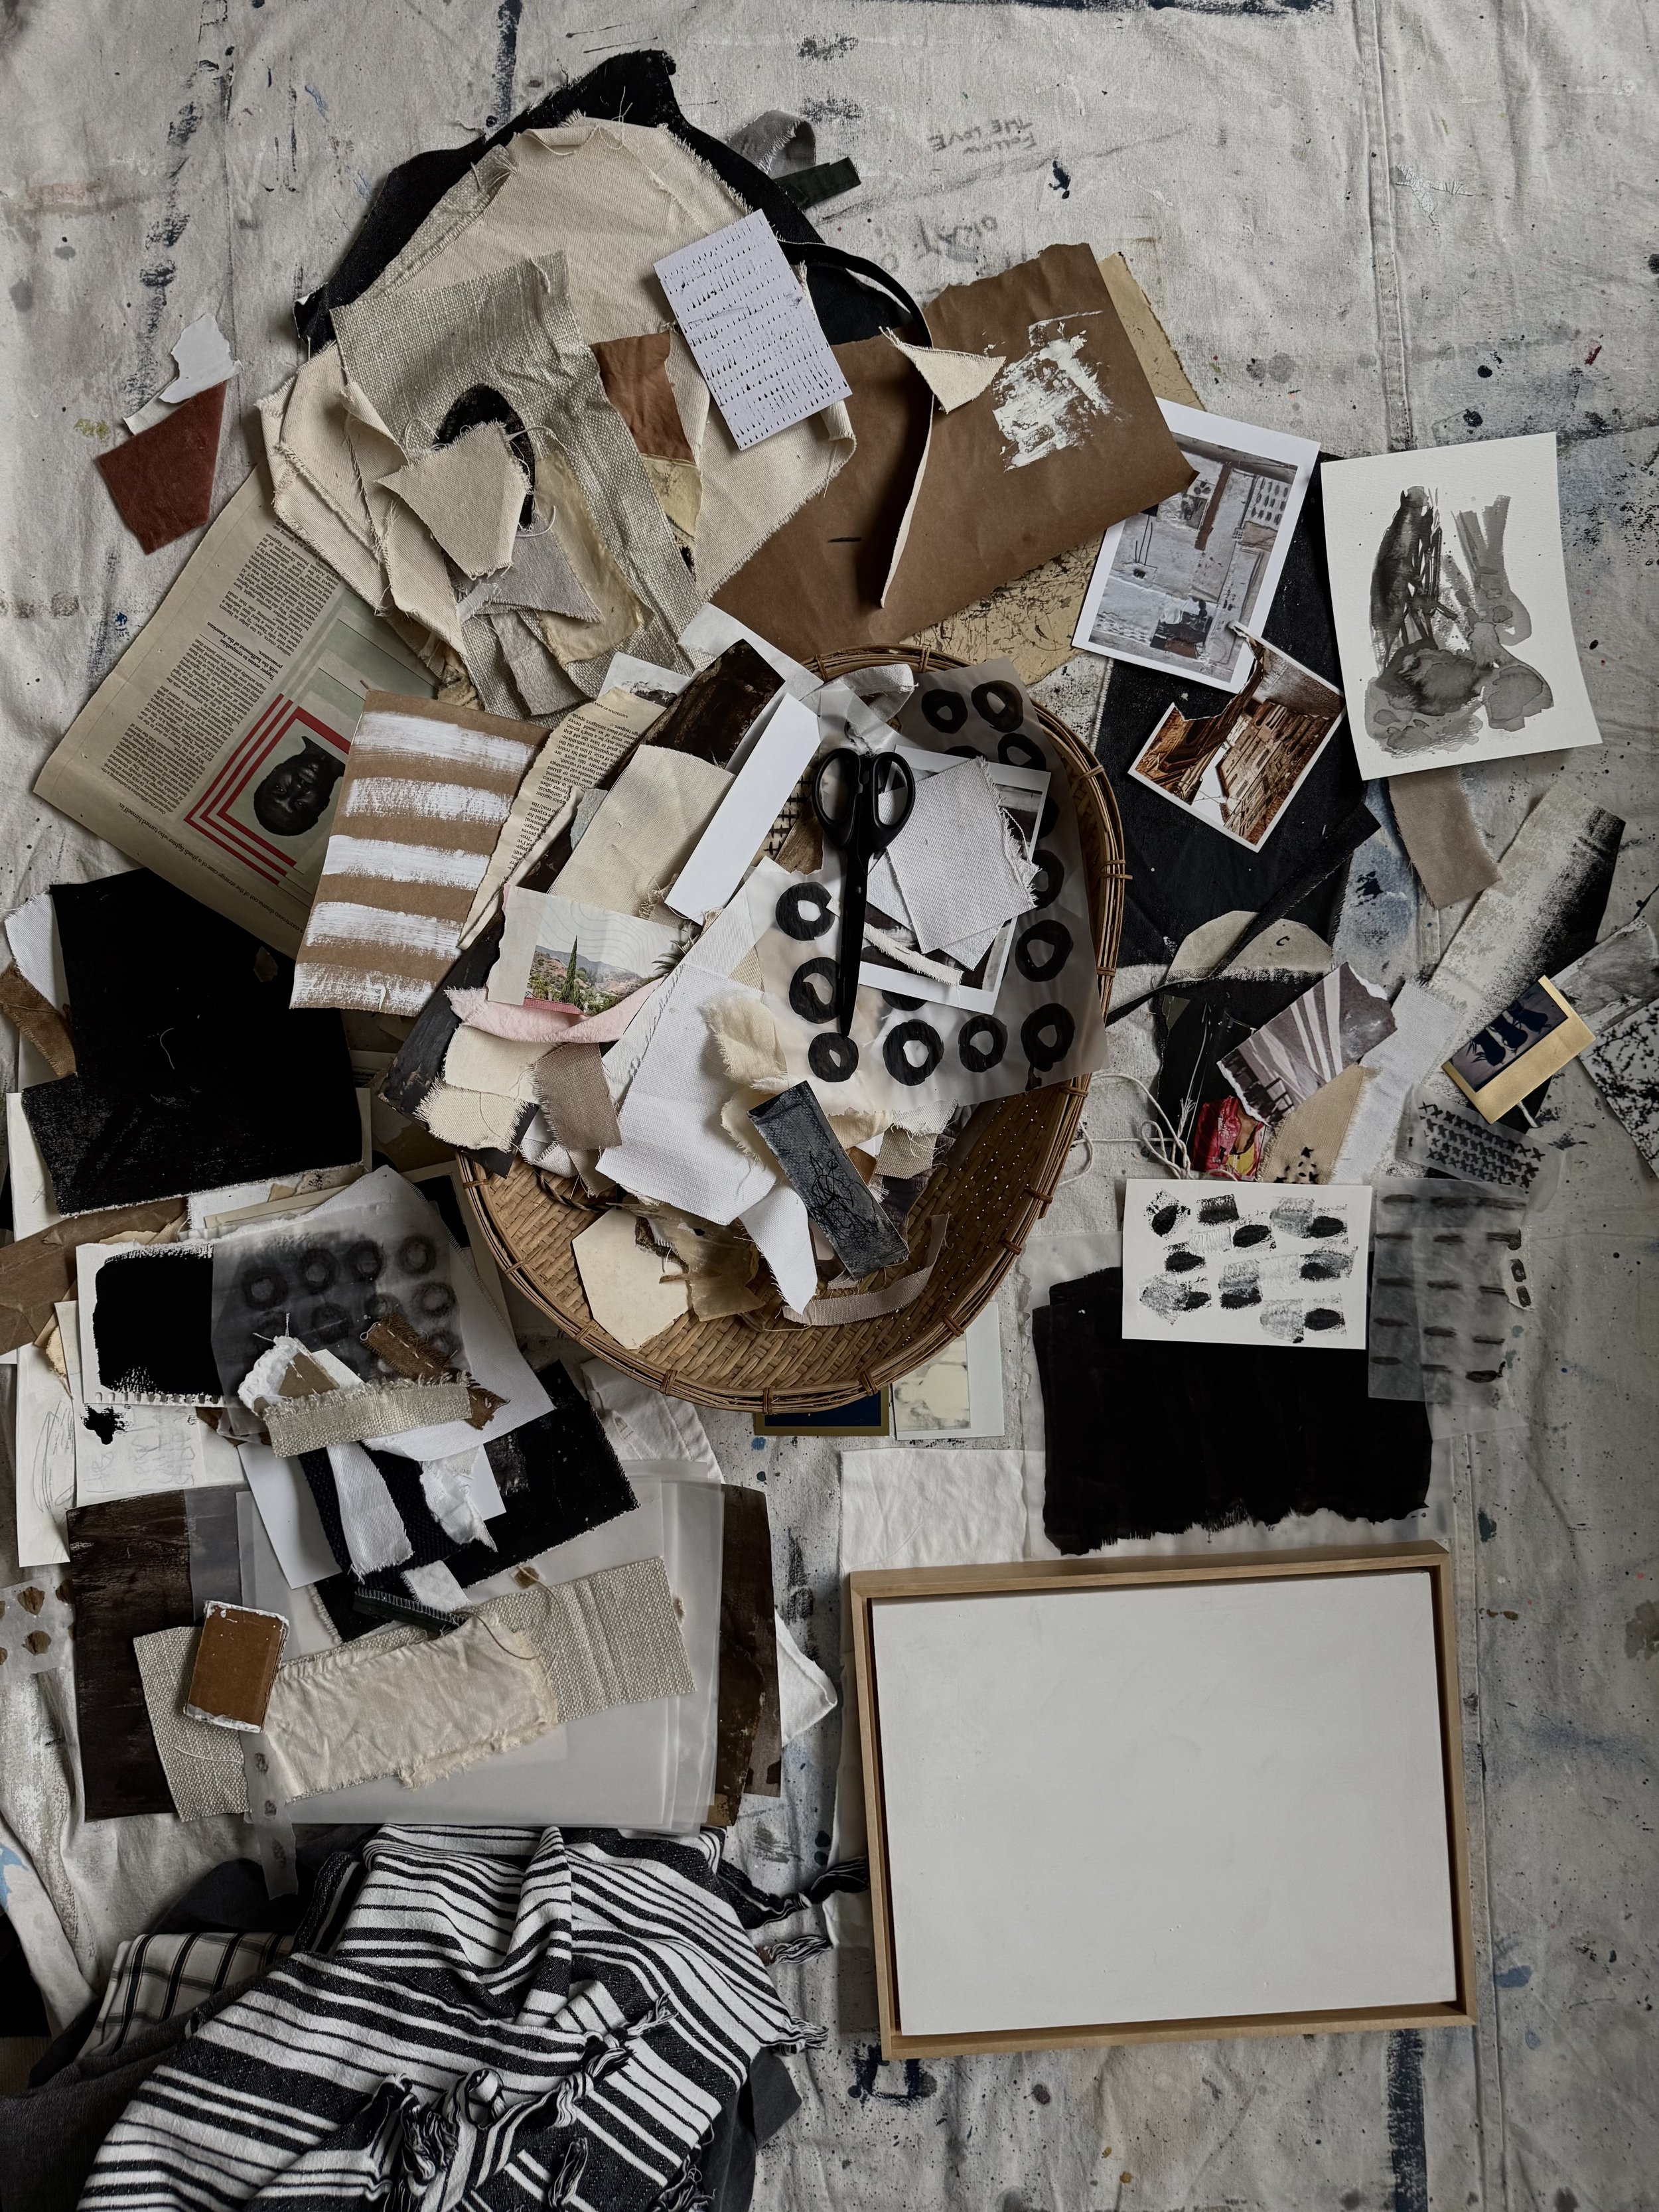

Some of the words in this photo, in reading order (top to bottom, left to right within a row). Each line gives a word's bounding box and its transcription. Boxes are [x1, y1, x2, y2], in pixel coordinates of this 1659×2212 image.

[991, 117, 1033, 133] THE
[206, 621, 228, 638] American
[219, 638, 243, 656] sympathize
[238, 644, 261, 663] bafflement
[248, 658, 260, 668] seems
[258, 650, 283, 668] prosecutors.
[259, 667, 274, 680] Tapper
[268, 665, 278, 674] with
[123, 806, 142, 822] himself
[141, 819, 158, 833] turned
[157, 830, 168, 840] who
[168, 838, 184, 851] fighter
[183, 848, 199, 861] jihadi
[206, 865, 218, 875] case
[217, 872, 236, 887] strange
[235, 885, 244, 893] the
[258, 900, 274, 913] drama
[274, 911, 300, 930] courtroom
